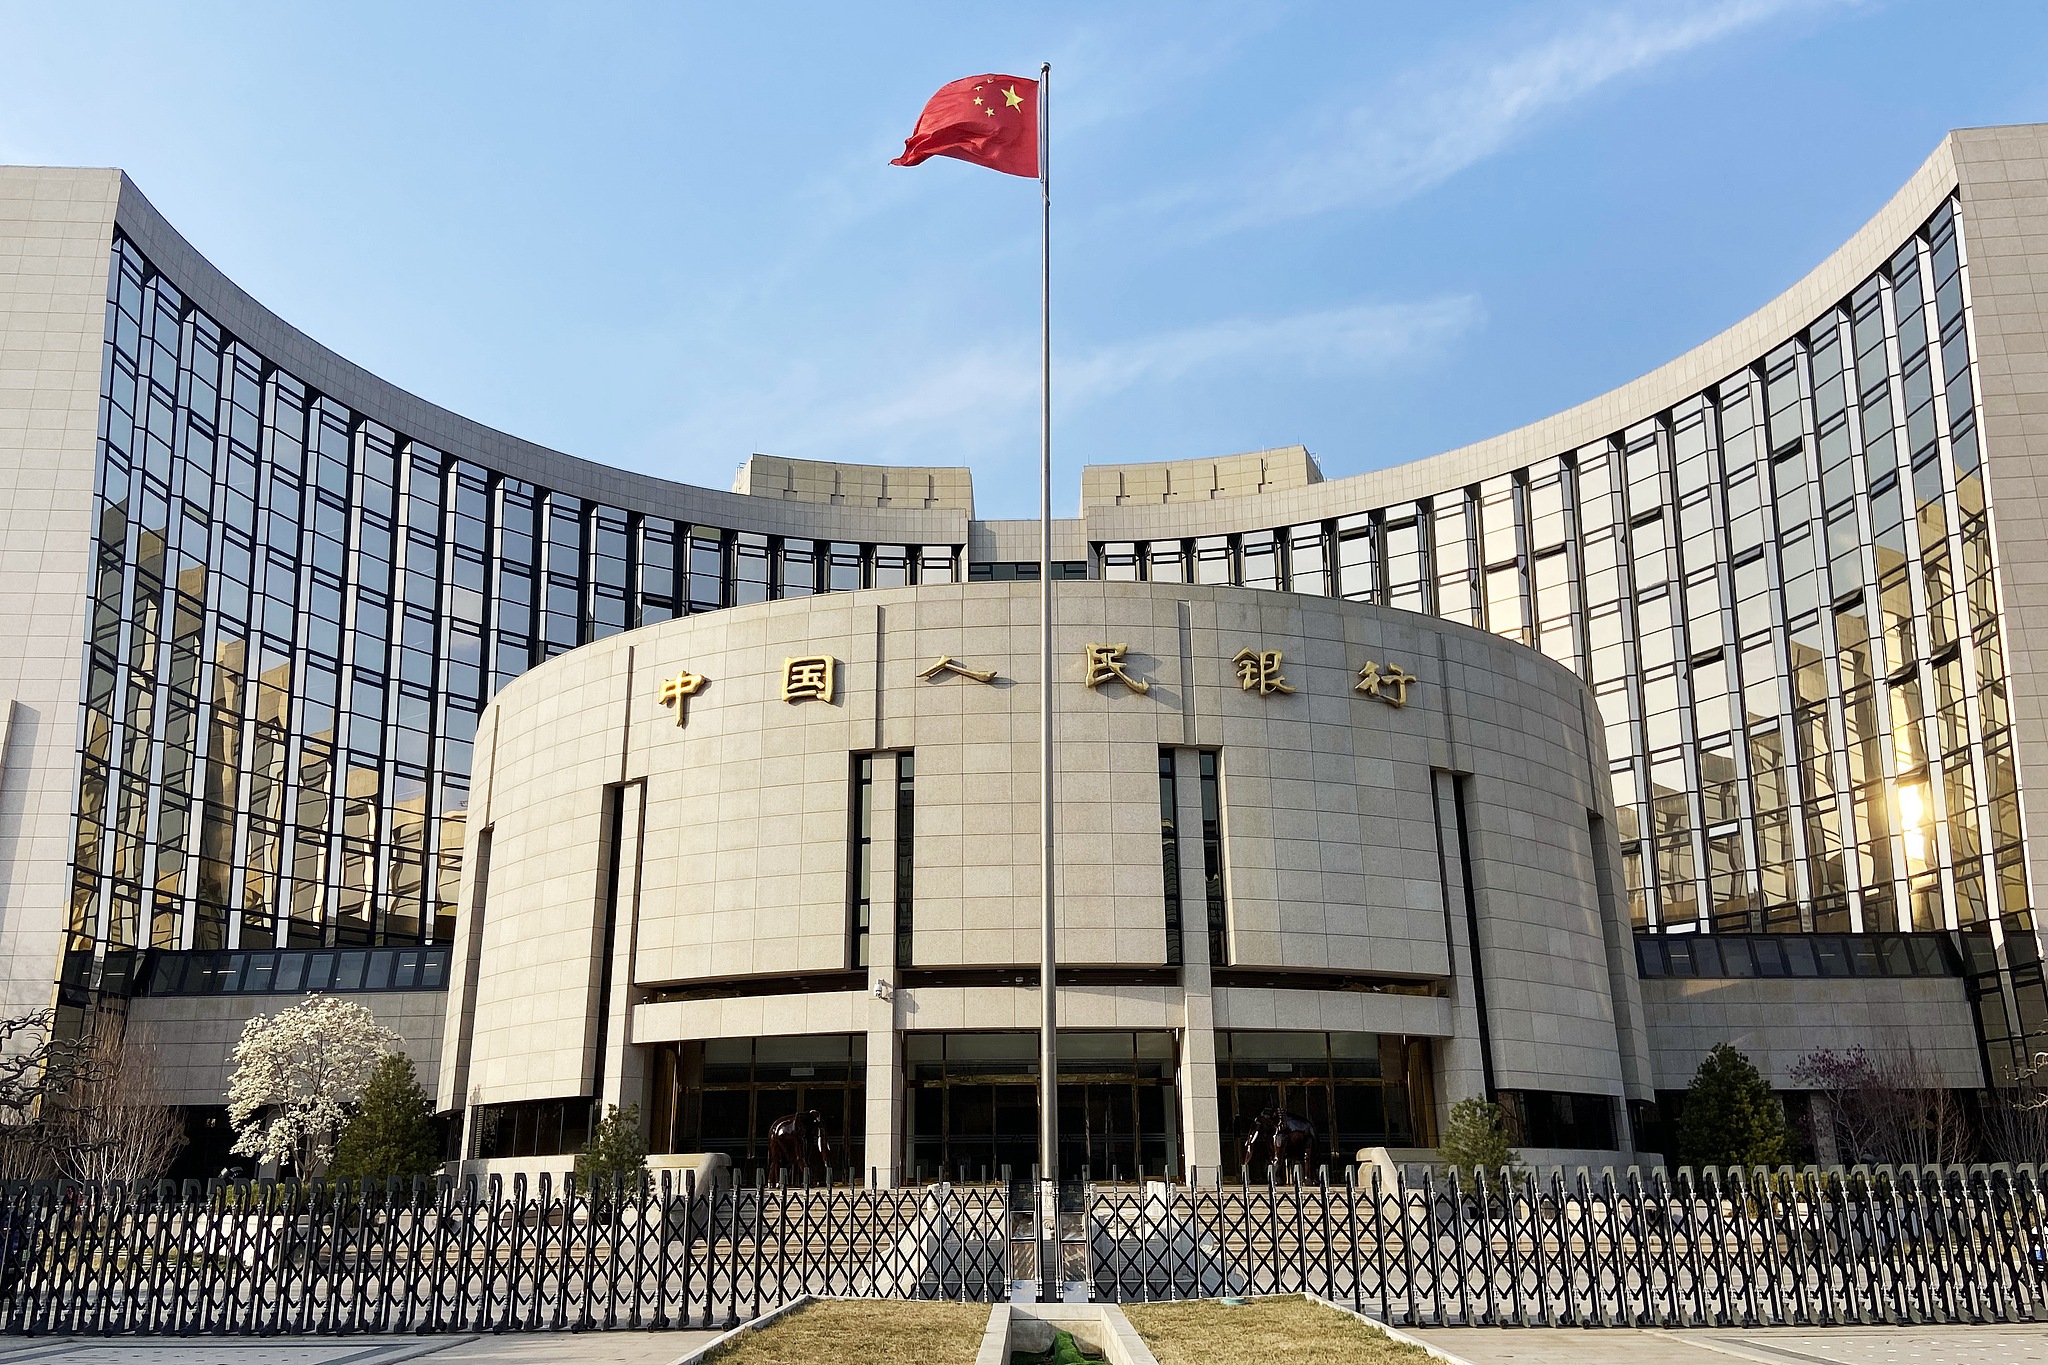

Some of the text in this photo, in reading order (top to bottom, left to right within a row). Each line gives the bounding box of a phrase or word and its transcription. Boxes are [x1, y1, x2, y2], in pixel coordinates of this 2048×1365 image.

[659, 642, 1416, 728] 中国人民银行
